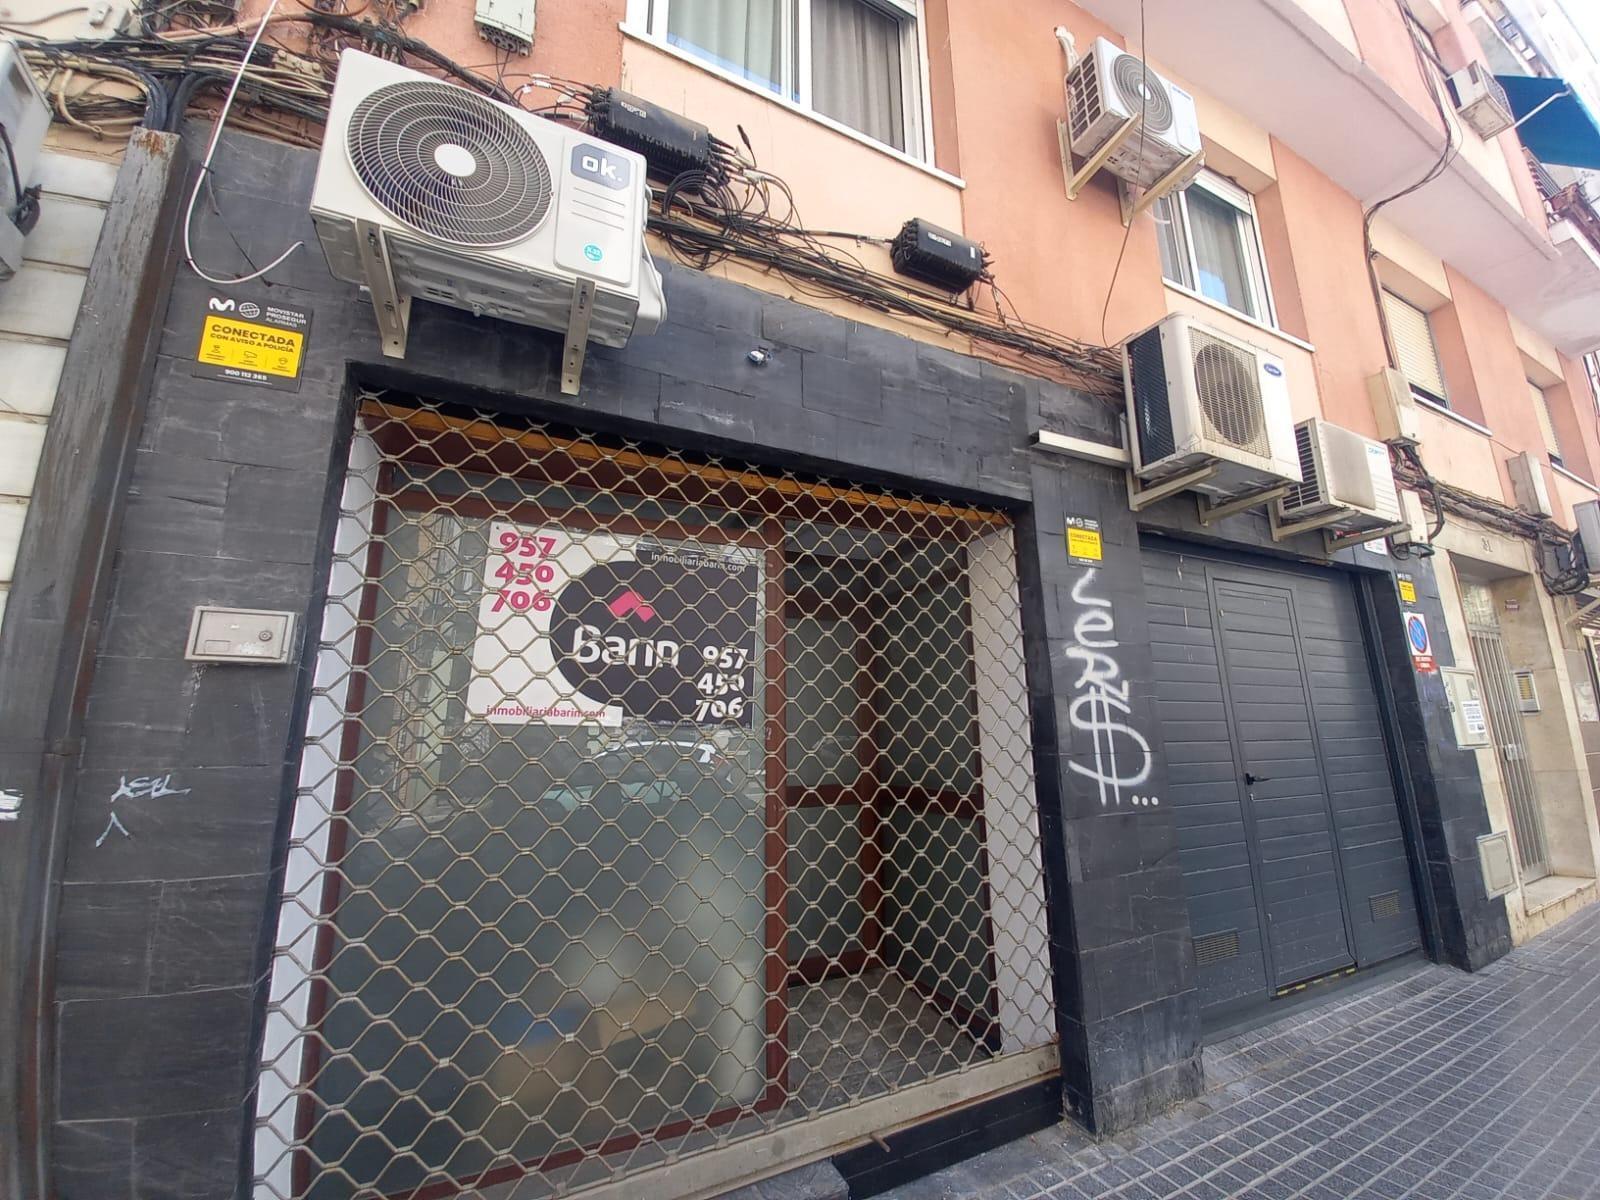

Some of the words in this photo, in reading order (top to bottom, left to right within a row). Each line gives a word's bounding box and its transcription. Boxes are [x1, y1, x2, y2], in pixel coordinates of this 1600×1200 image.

[265, 311, 307, 325] PROSEGUR
[265, 317, 298, 328] ALARMAS
[266, 306, 304, 319] MOVISTAR
[210, 332, 229, 342] CON
[230, 336, 256, 346] AVISO
[263, 343, 294, 354] POLICÍA
[211, 324, 295, 347] CONECTADA
[224, 368, 240, 377] 900
[241, 370, 252, 379] 112
[500, 532, 557, 559] 957
[495, 561, 555, 586] 450
[491, 589, 551, 612] 706
[572, 624, 680, 669] Barin
[703, 645, 749, 670] 957
[697, 672, 745, 695] 450
[695, 696, 744, 722] 706
